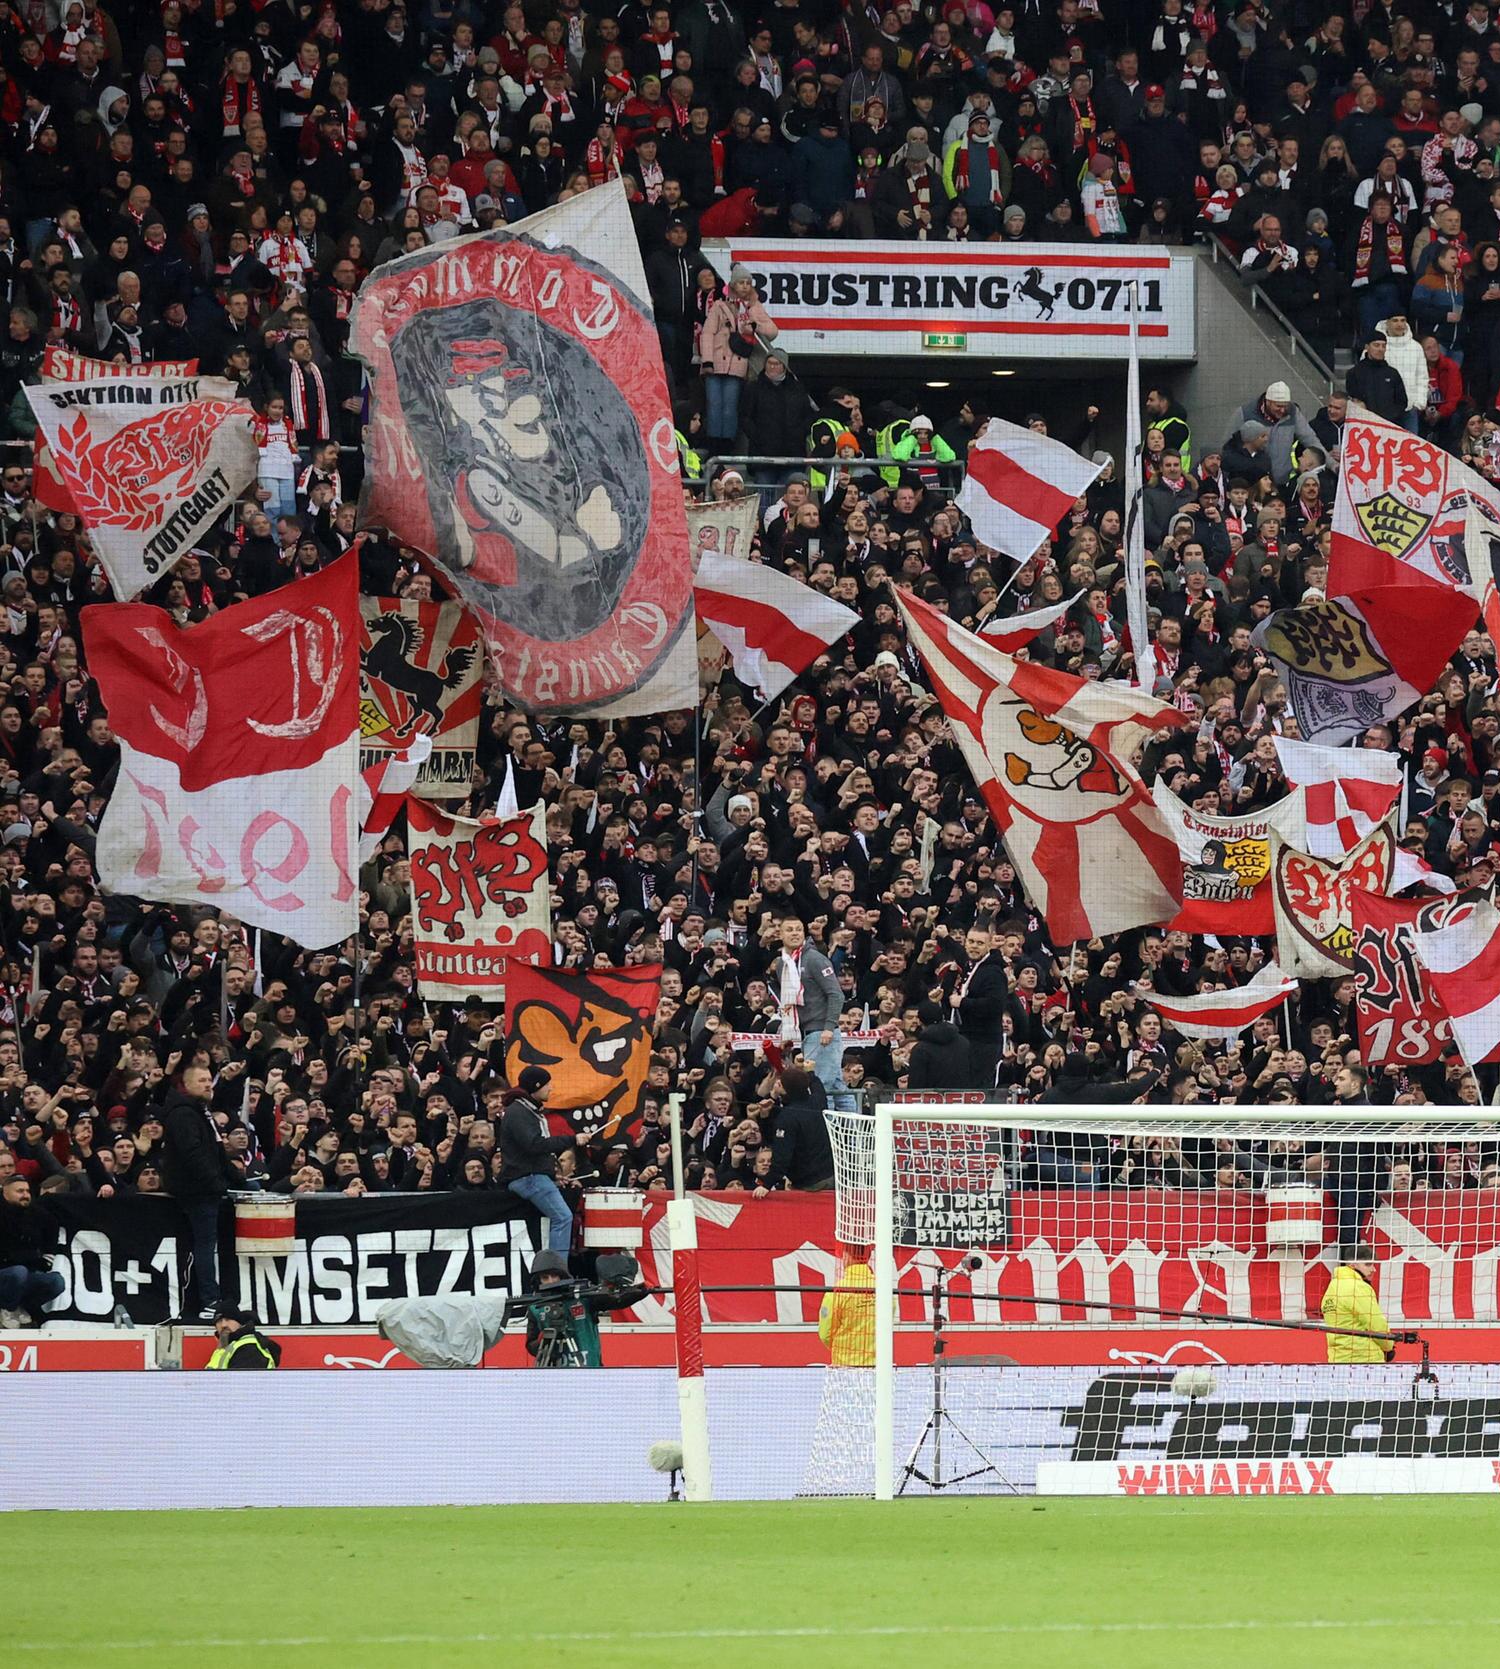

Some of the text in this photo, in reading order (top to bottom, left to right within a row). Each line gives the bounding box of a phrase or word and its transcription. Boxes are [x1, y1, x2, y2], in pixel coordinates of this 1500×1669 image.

[752, 272, 1163, 312] BRUSTRING 0711
[49, 384, 152, 409] SEKTION
[143, 466, 232, 574] STUTTGART
[1184, 869, 1254, 902] Buben
[418, 949, 541, 976] Stuttgat
[894, 1152, 1001, 1171] TÄRKER
[914, 1192, 1003, 1209] DU BIST
[916, 1210, 1004, 1228] IMMER
[917, 1229, 951, 1242] BEI
[1117, 1460, 1336, 1495] WINAMAX
